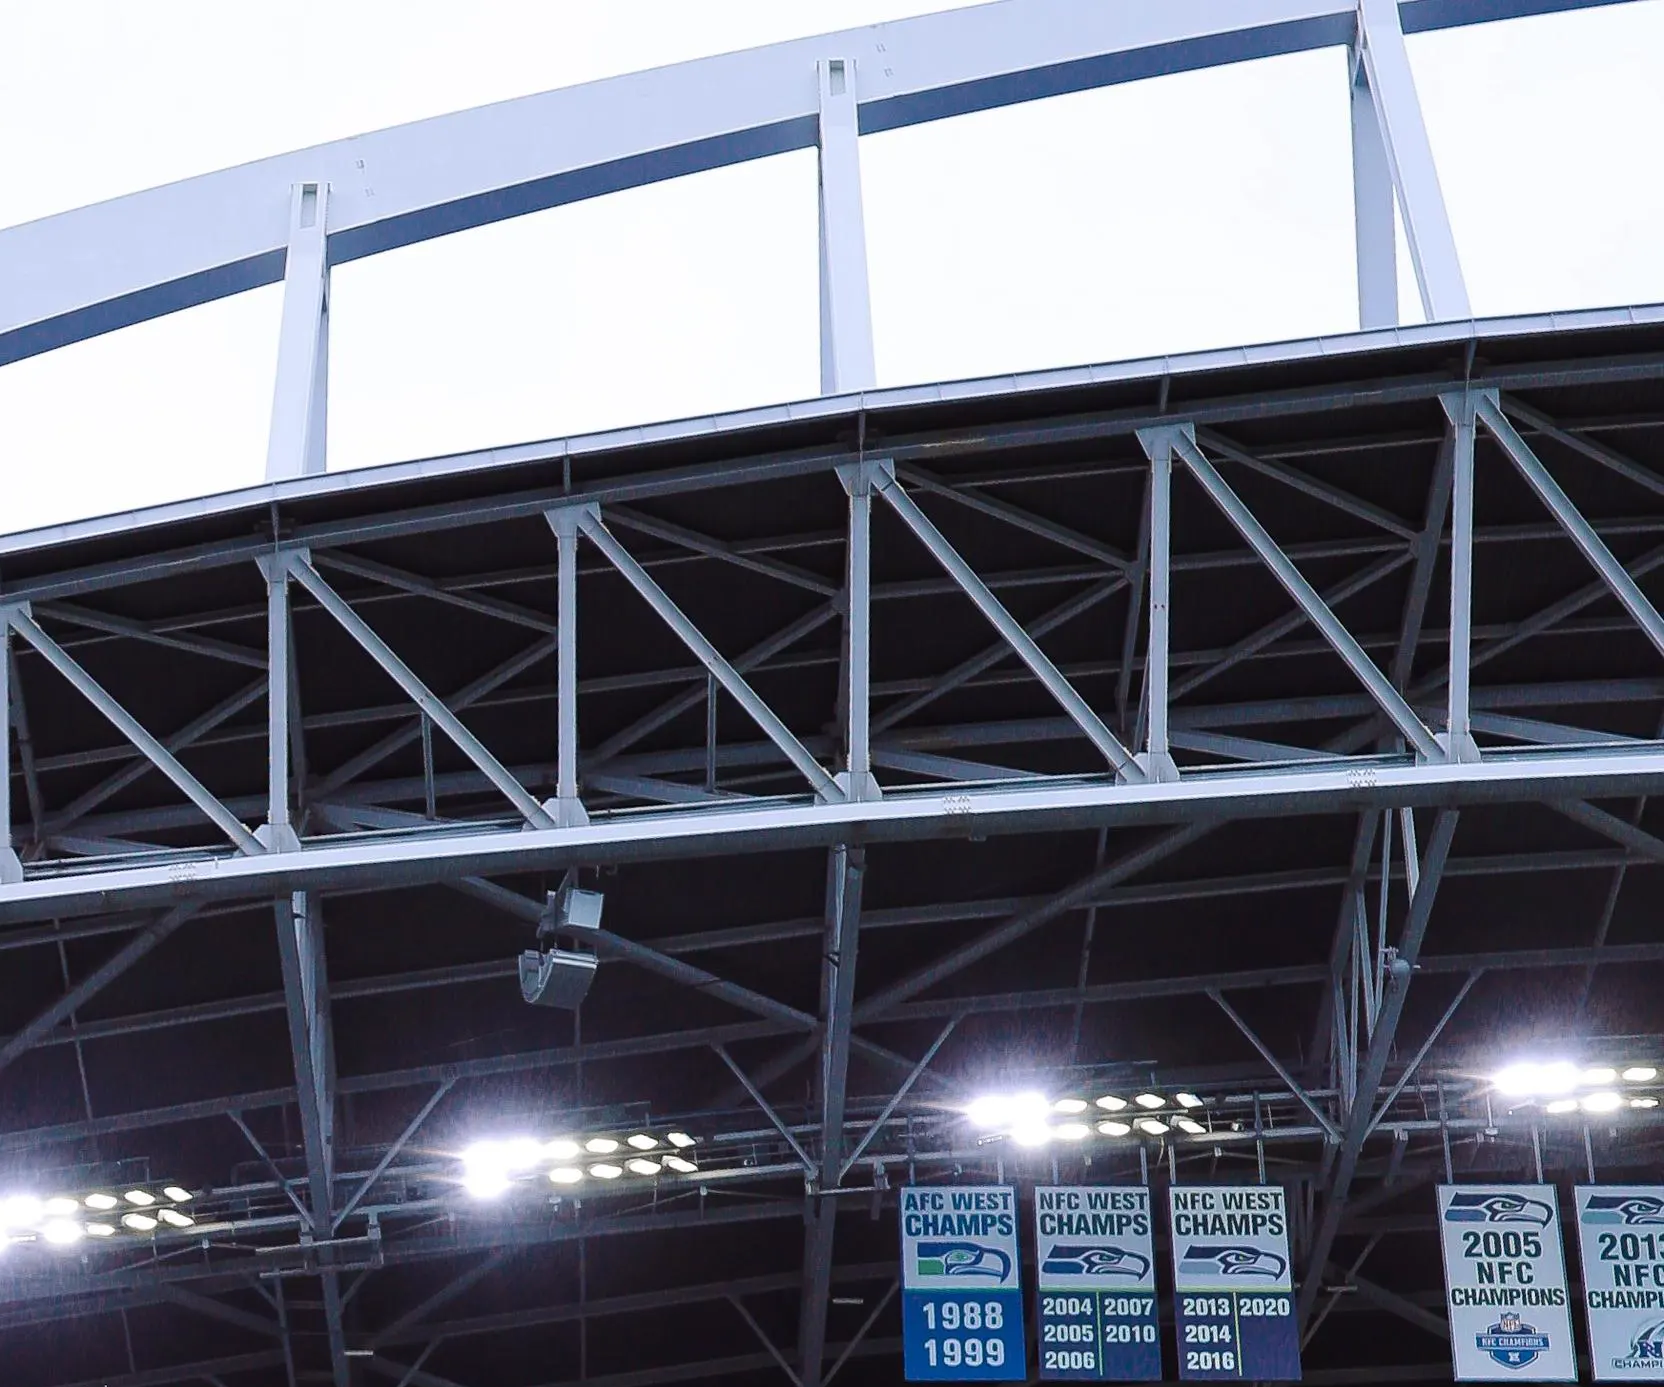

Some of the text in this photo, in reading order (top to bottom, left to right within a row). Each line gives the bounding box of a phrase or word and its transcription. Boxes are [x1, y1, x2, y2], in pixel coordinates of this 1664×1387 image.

[905, 1192, 1011, 1211] AFC WEST
[1039, 1192, 1148, 1211] NFC WEST
[1174, 1192, 1283, 1211] NFC WEST
[905, 1213, 1013, 1237] CHAMPS
[1039, 1213, 1149, 1237] CHAMPS
[1174, 1213, 1285, 1237] CHAMPS
[1462, 1231, 1542, 1259] 2005
[1598, 1232, 1664, 1261] 201
[1476, 1261, 1534, 1285] NFC
[1451, 1287, 1566, 1307] CHAMPIONS
[922, 1301, 1004, 1330] 1988
[1042, 1298, 1154, 1317] 2004 2007
[1183, 1298, 1290, 1317] 2013 2020
[1044, 1324, 1156, 1343] 2005 2010
[1185, 1324, 1232, 1343] 2014
[1481, 1336, 1545, 1347] NFC CHAMPIONS
[924, 1338, 1005, 1367] 1999
[1045, 1351, 1095, 1371] 2006
[1186, 1351, 1235, 1371] 2016
